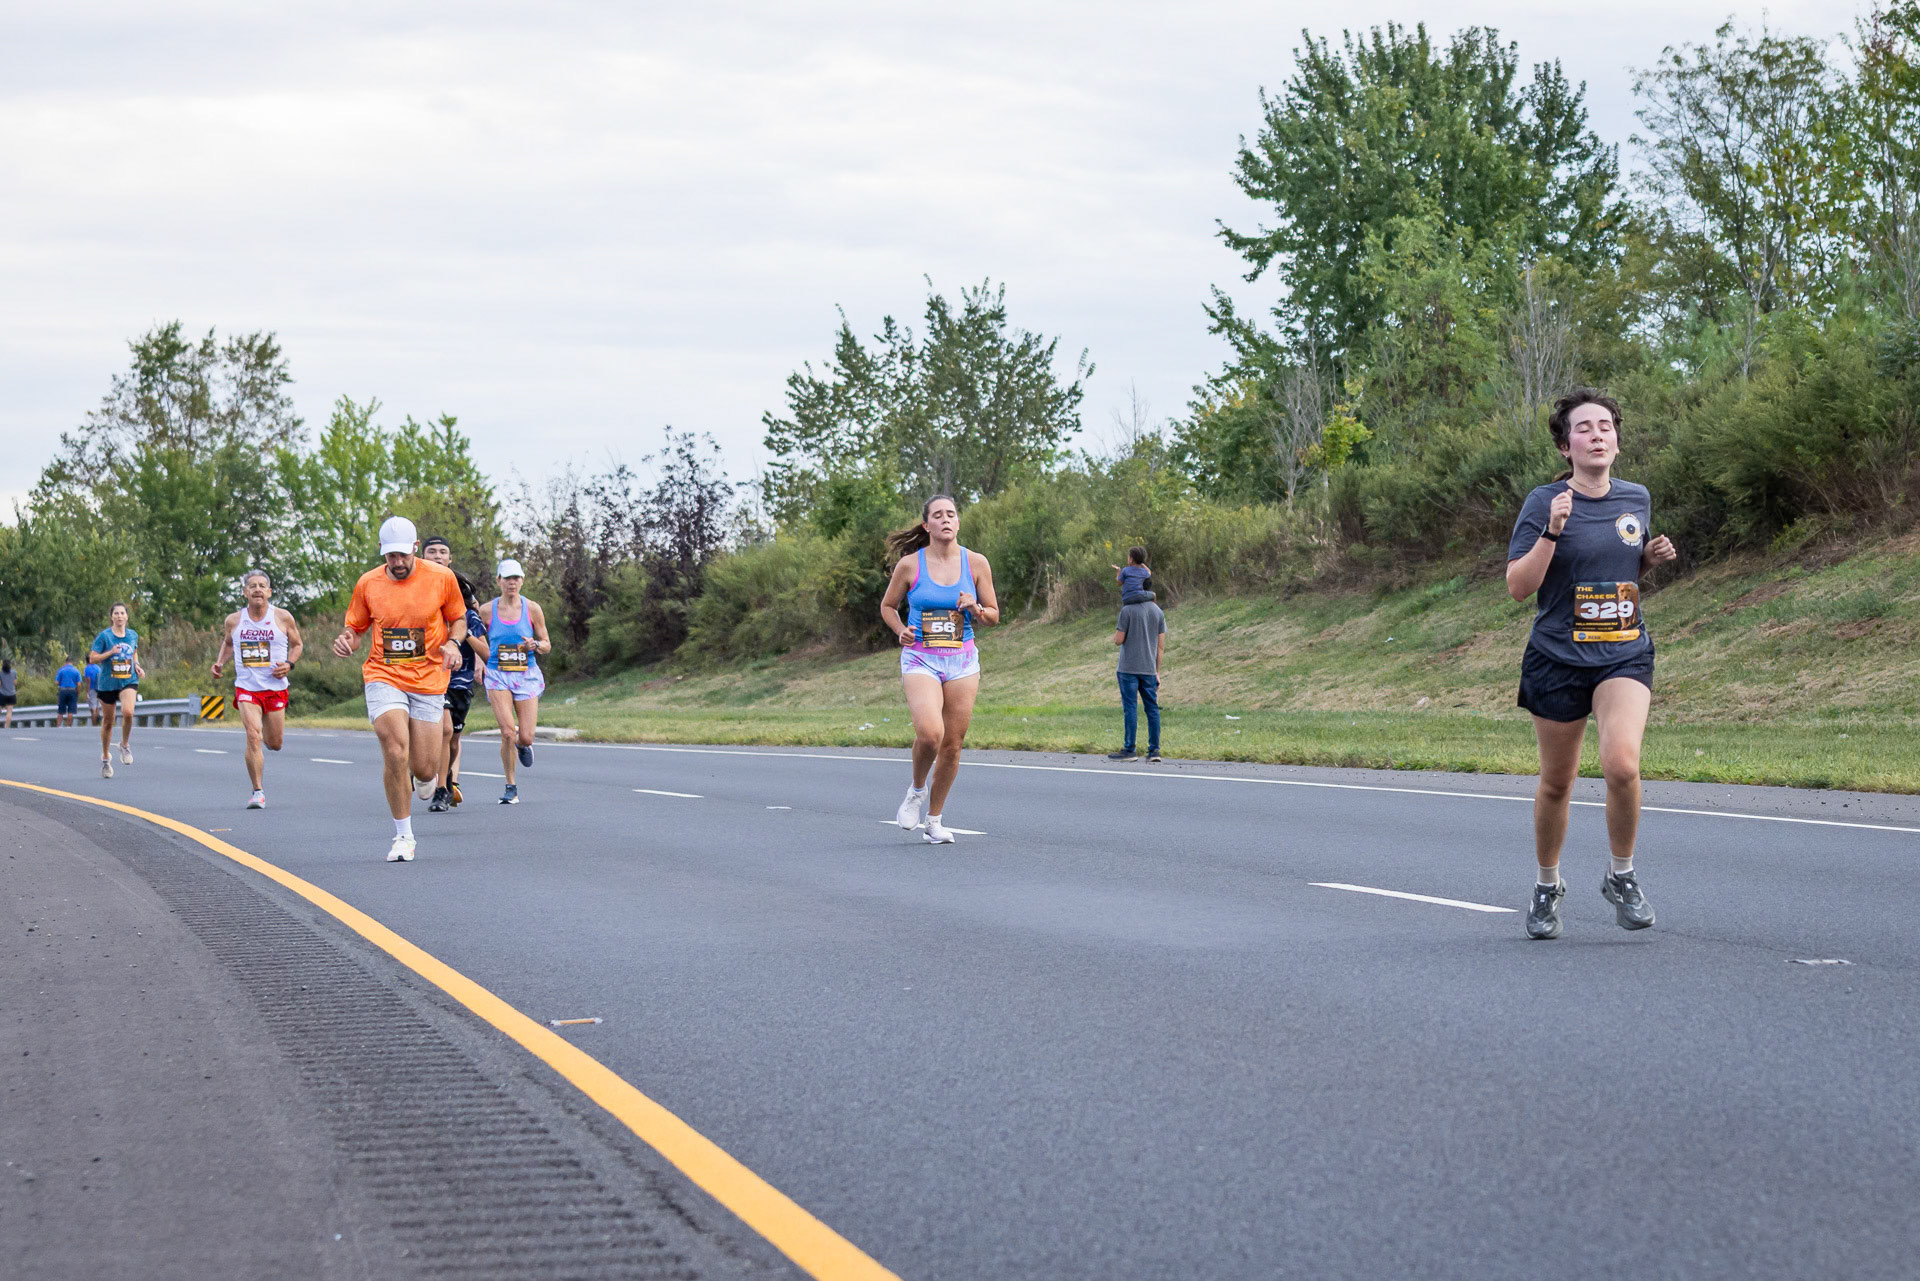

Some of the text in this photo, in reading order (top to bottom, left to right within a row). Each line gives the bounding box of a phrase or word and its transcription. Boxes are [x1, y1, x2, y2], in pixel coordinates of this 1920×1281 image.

[1580, 601, 1634, 619] 329
[931, 621, 956, 633] 56
[240, 629, 275, 637] LEONIA
[391, 640, 416, 651] 80
[242, 649, 269, 659] 243
[500, 652, 527, 661] 348
